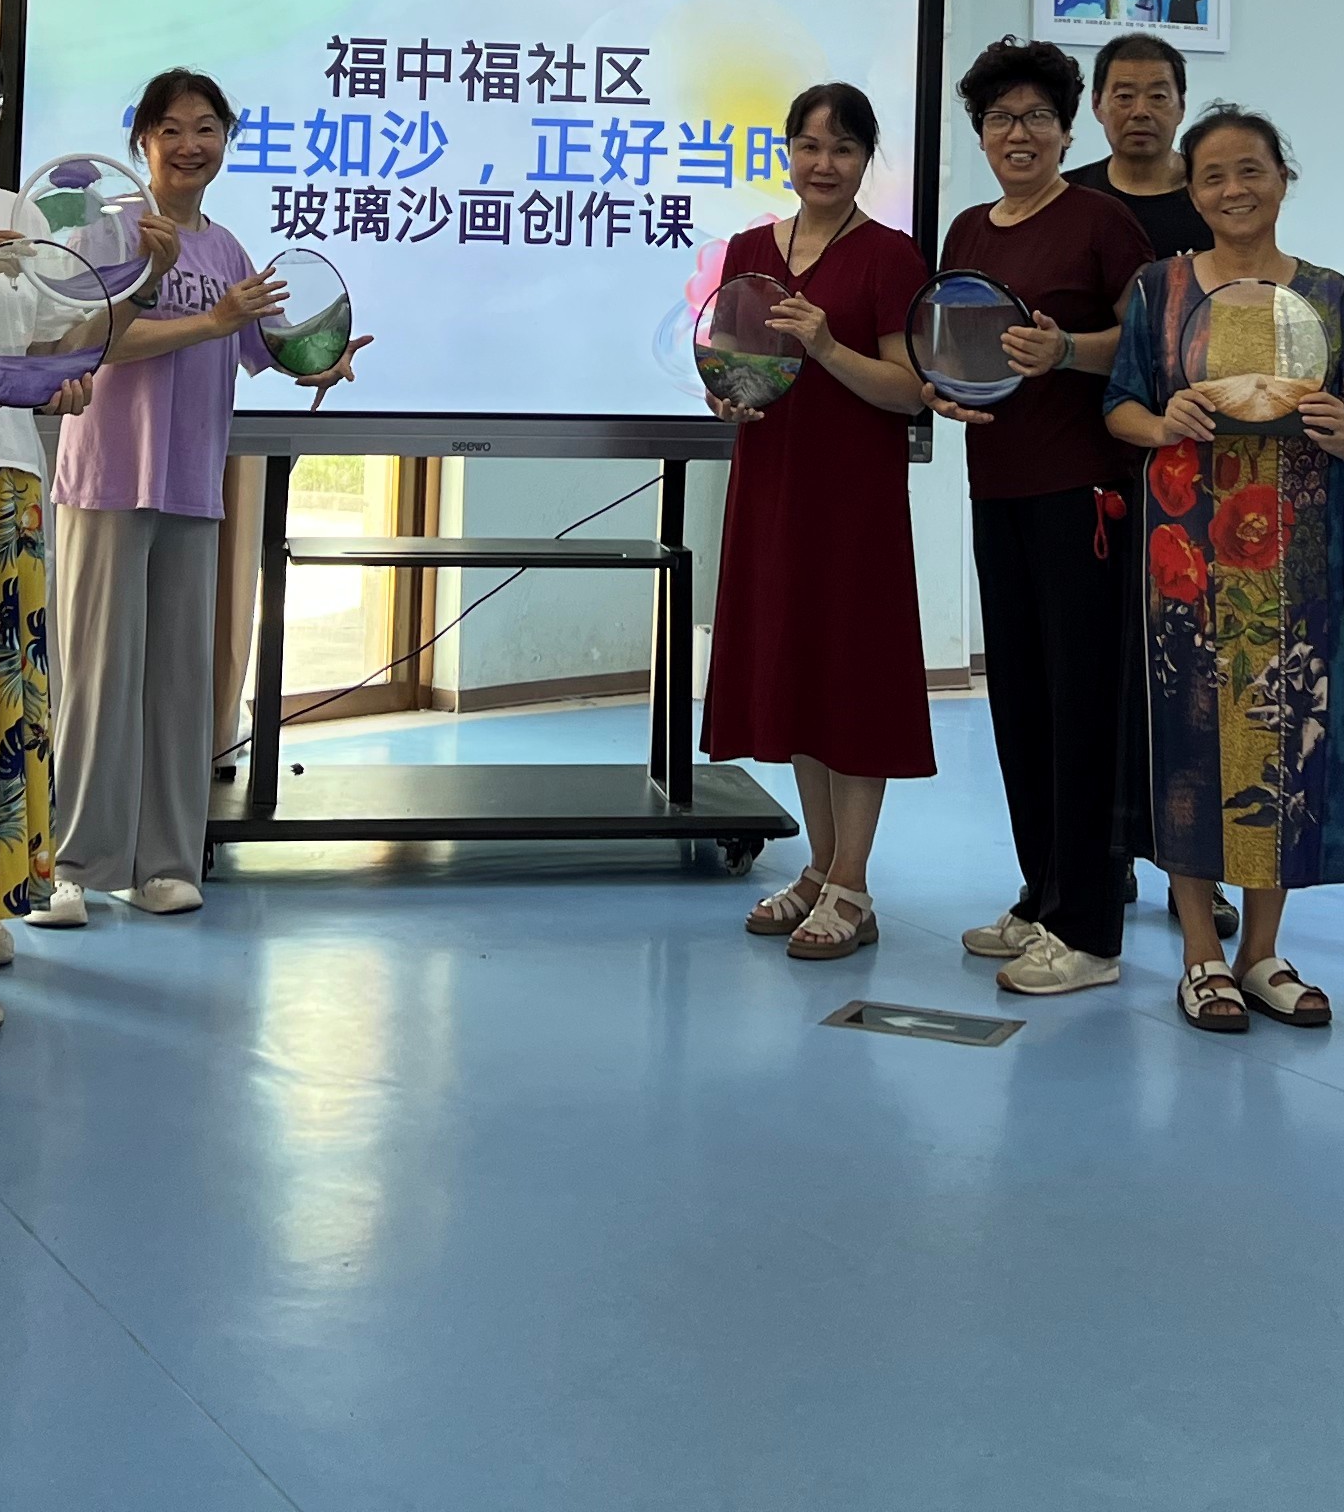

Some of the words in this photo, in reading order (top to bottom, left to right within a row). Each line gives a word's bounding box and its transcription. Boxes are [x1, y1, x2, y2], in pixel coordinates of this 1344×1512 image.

[324, 34, 651, 106] 福中福社区
[270, 184, 694, 249] 玻璃沙画创作课
[452, 441, 491, 452] seewo
